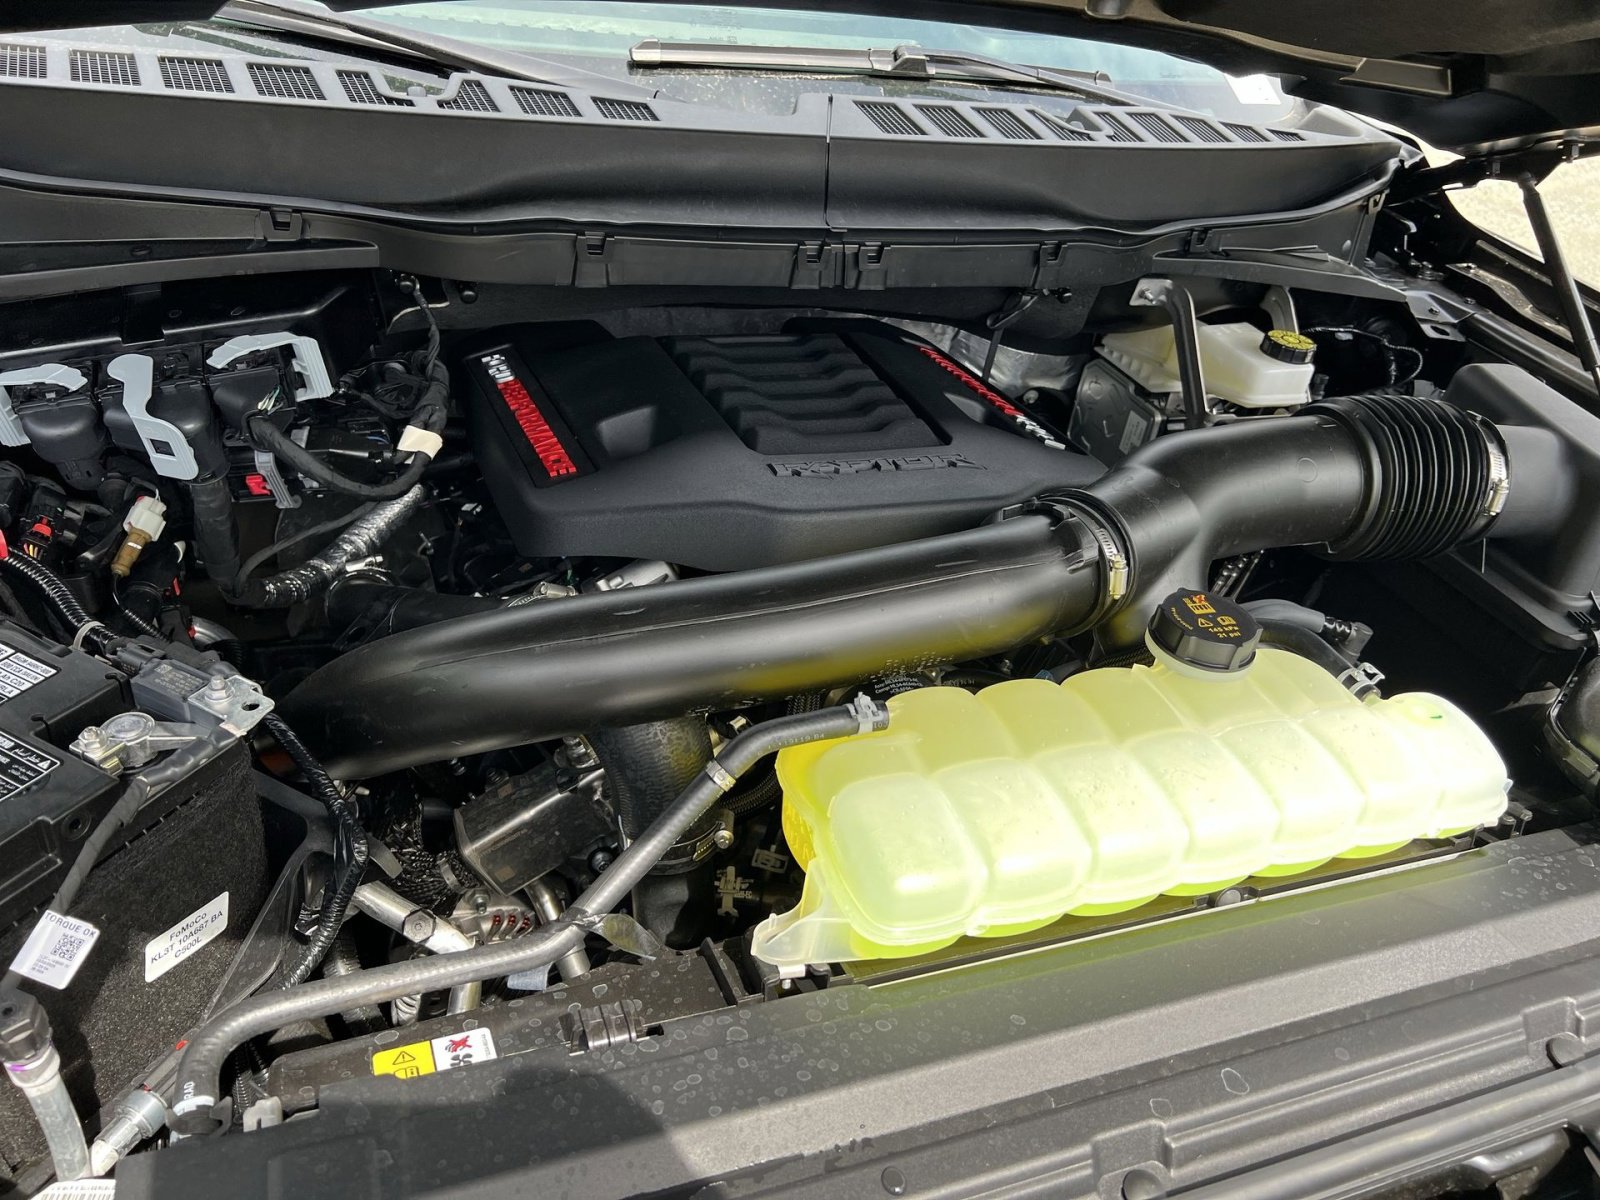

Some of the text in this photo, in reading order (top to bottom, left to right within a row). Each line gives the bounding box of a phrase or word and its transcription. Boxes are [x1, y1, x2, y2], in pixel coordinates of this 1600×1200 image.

[496, 379, 577, 478] PERFORMANCE
[766, 453, 988, 480] RAPTOR
[44, 912, 97, 938] TORQUE OK
[150, 910, 224, 964] KL3T 10A687 BA
[169, 912, 207, 941] FoMoCo
